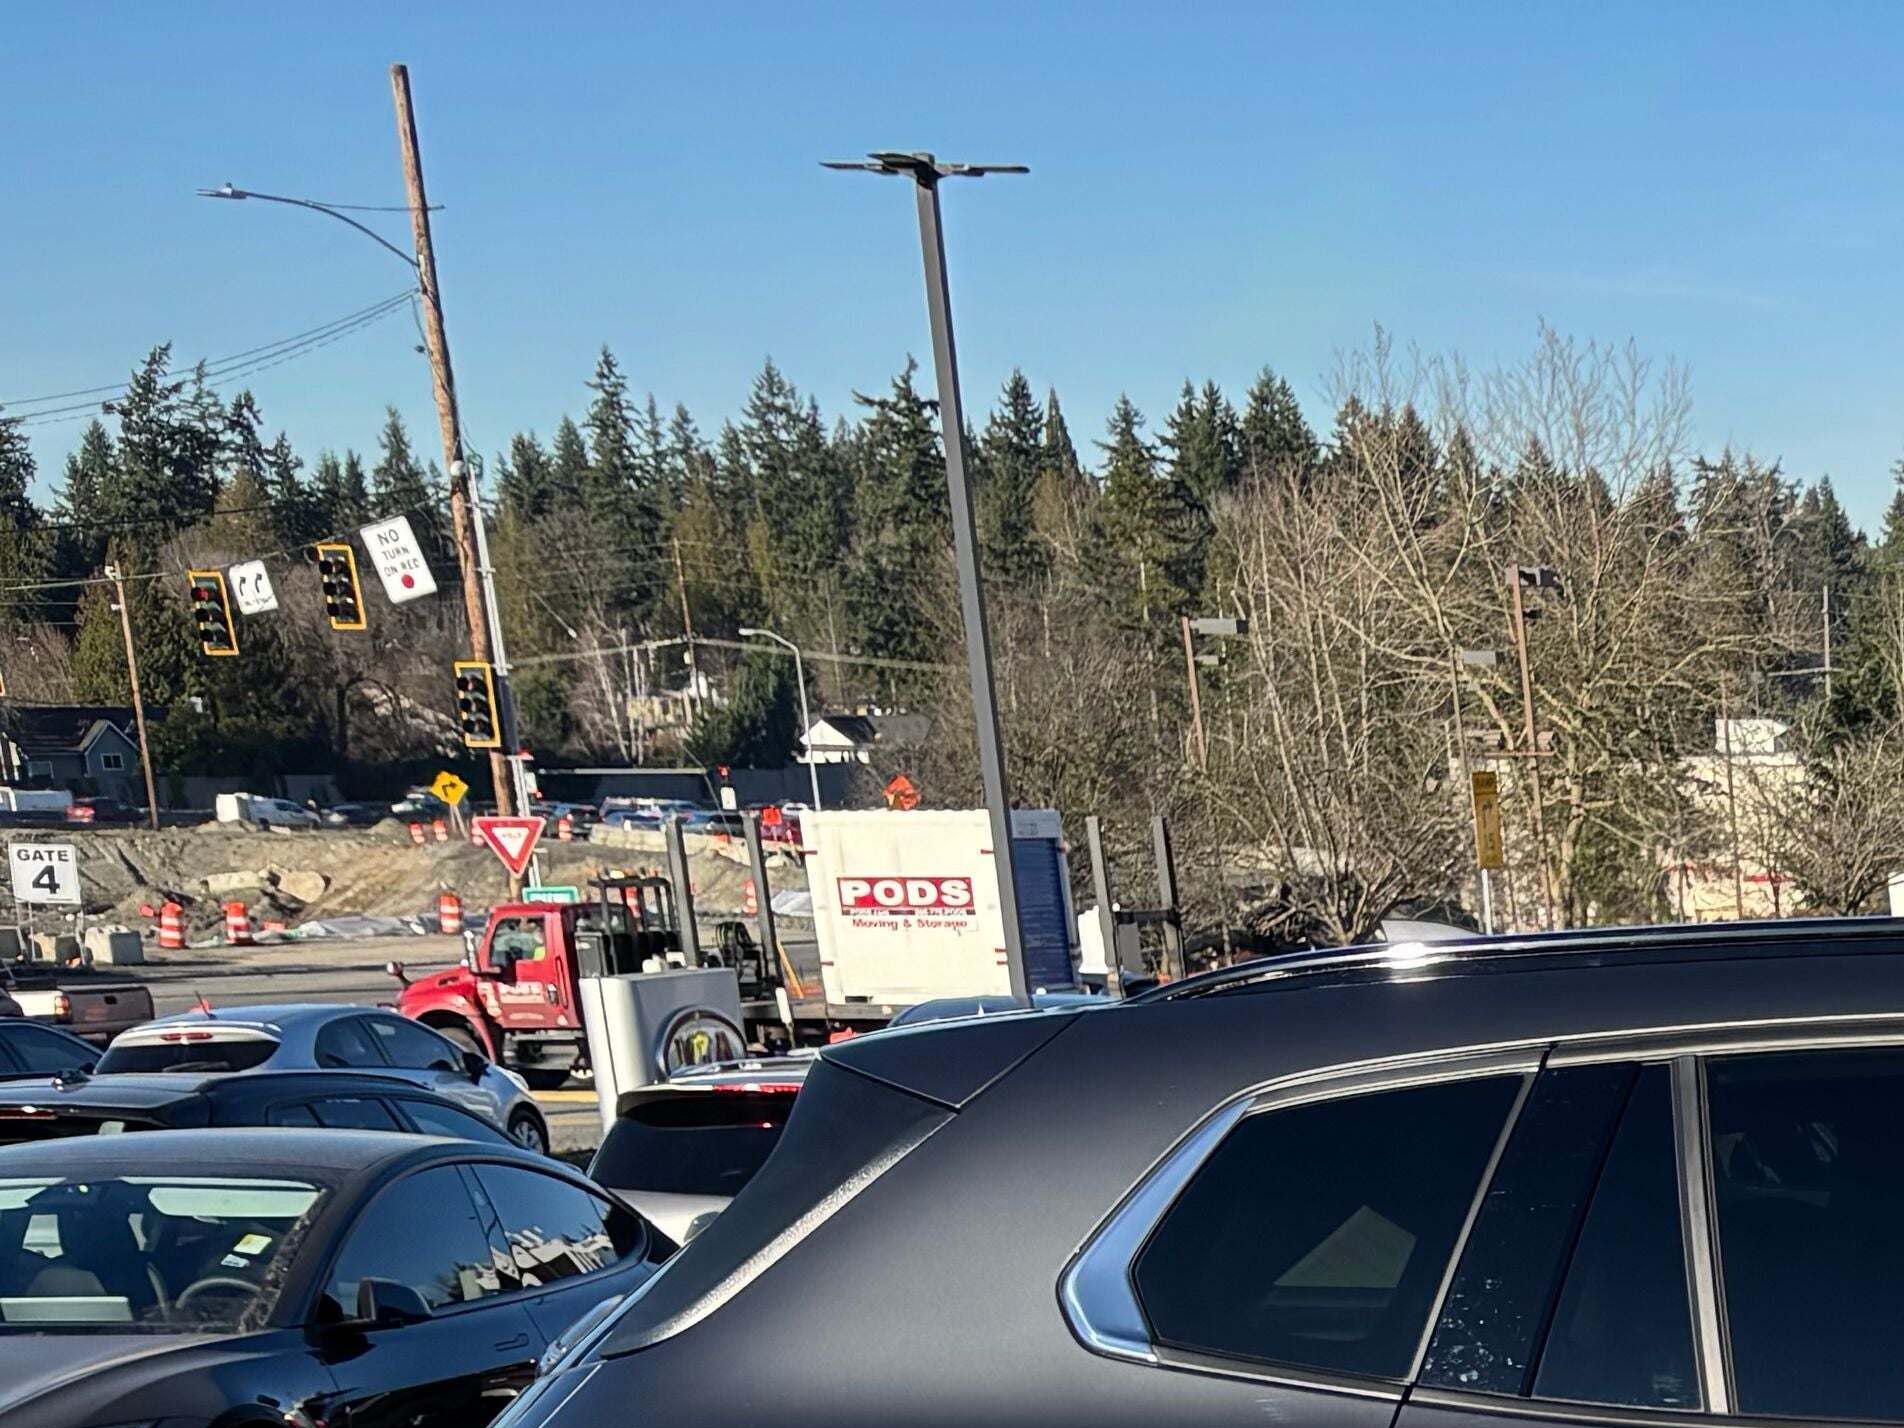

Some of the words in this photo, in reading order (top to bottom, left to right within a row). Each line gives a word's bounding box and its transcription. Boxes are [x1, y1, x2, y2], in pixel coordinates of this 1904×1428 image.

[377, 529, 399, 545] NO
[381, 546, 410, 560] TURN
[384, 565, 398, 577] ON
[16, 848, 69, 862] GATE
[32, 865, 60, 894] 4
[840, 879, 971, 906] PODS
[852, 918, 898, 930] Moving
[903, 918, 912, 928] &
[917, 918, 967, 930] Storage
